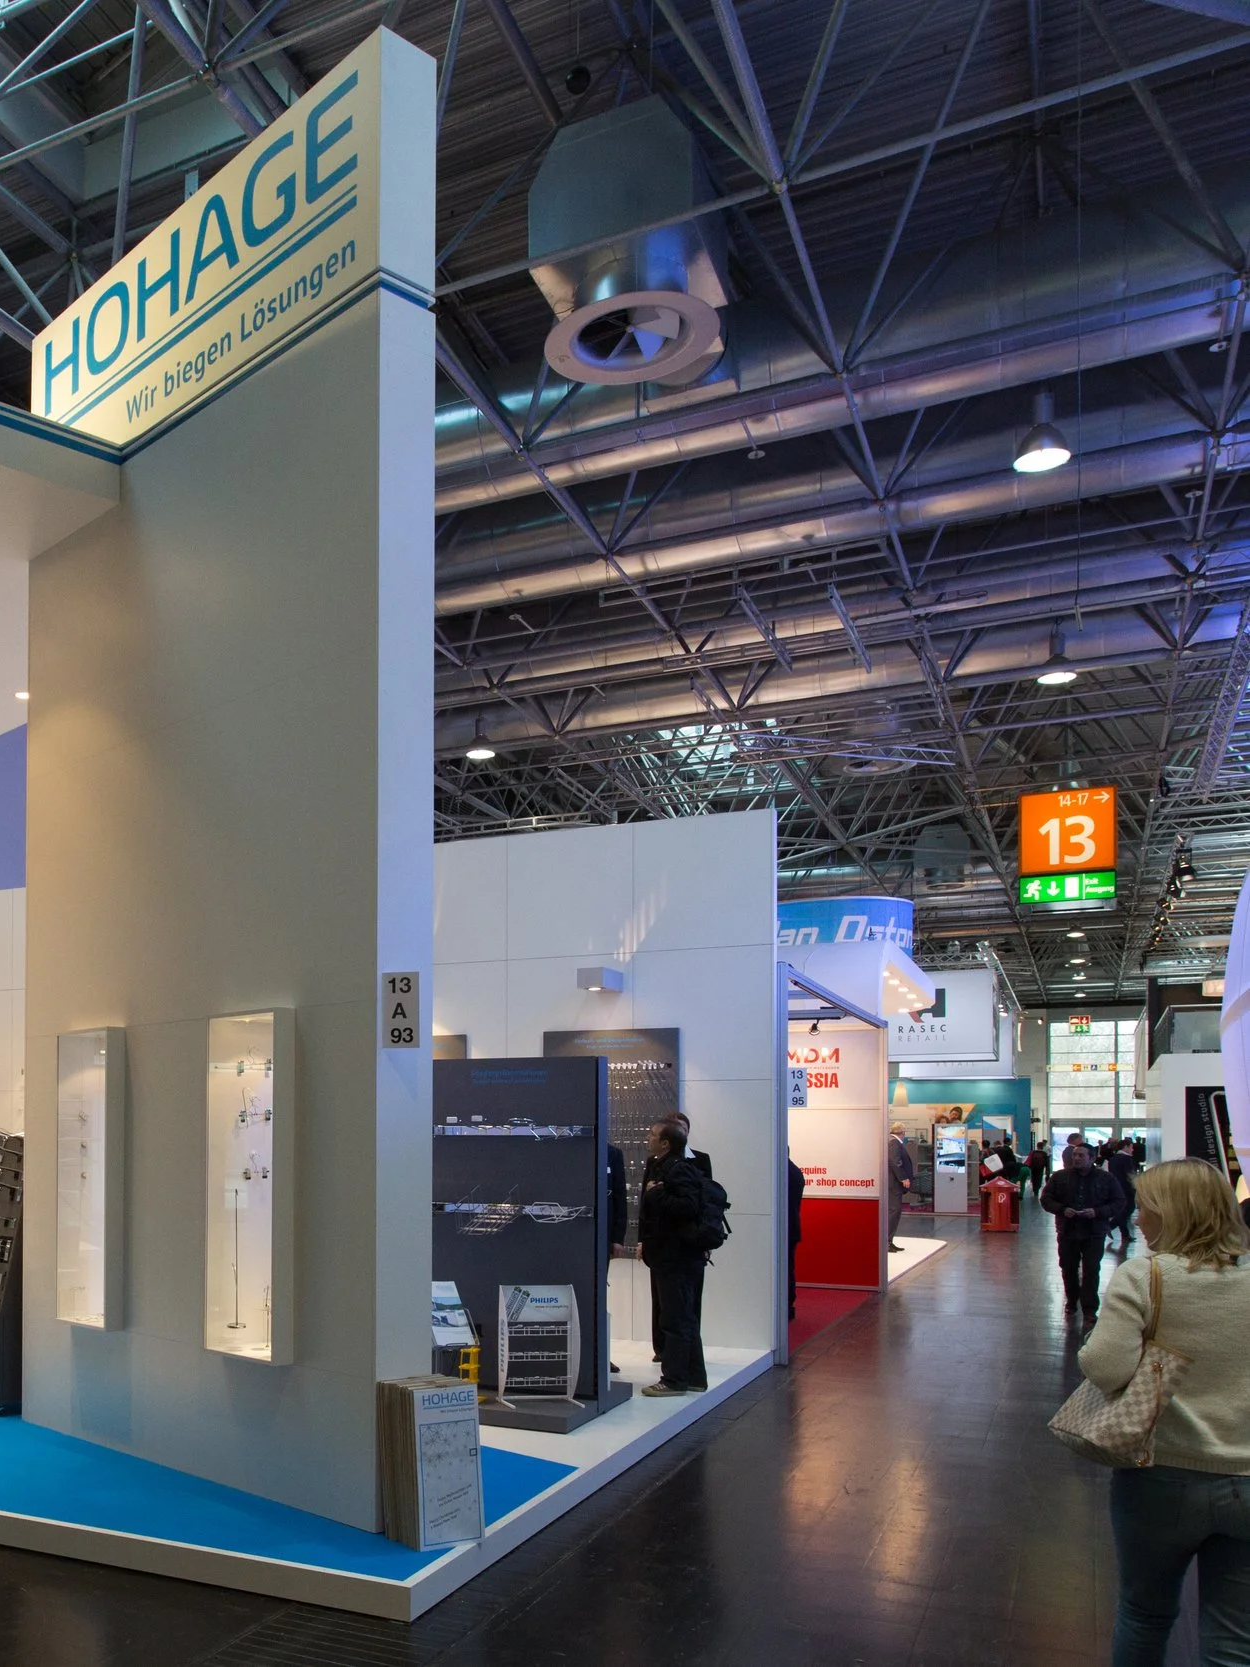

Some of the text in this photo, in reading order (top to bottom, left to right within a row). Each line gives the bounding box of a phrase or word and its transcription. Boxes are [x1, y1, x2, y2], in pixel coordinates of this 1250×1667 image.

[45, 69, 359, 416] HOHAGE
[126, 239, 357, 423] Wir biegen Lösungen
[1058, 792, 1089, 807] 14-17
[1038, 815, 1096, 865] 13
[388, 976, 412, 994] 13
[391, 1002, 407, 1019] A
[390, 1027, 414, 1044] 93
[898, 1024, 947, 1034] RASEC
[791, 1070, 804, 1080] 13
[806, 1072, 839, 1089] SSIA
[792, 1083, 801, 1093] A
[791, 1096, 805, 1106] 95
[1198, 1093, 1210, 1122] studio
[1203, 1125, 1216, 1155] design
[799, 1166, 827, 1175] equins
[816, 1178, 837, 1187] shop
[839, 1178, 875, 1188] concept
[422, 1390, 475, 1406] HOHAGE
